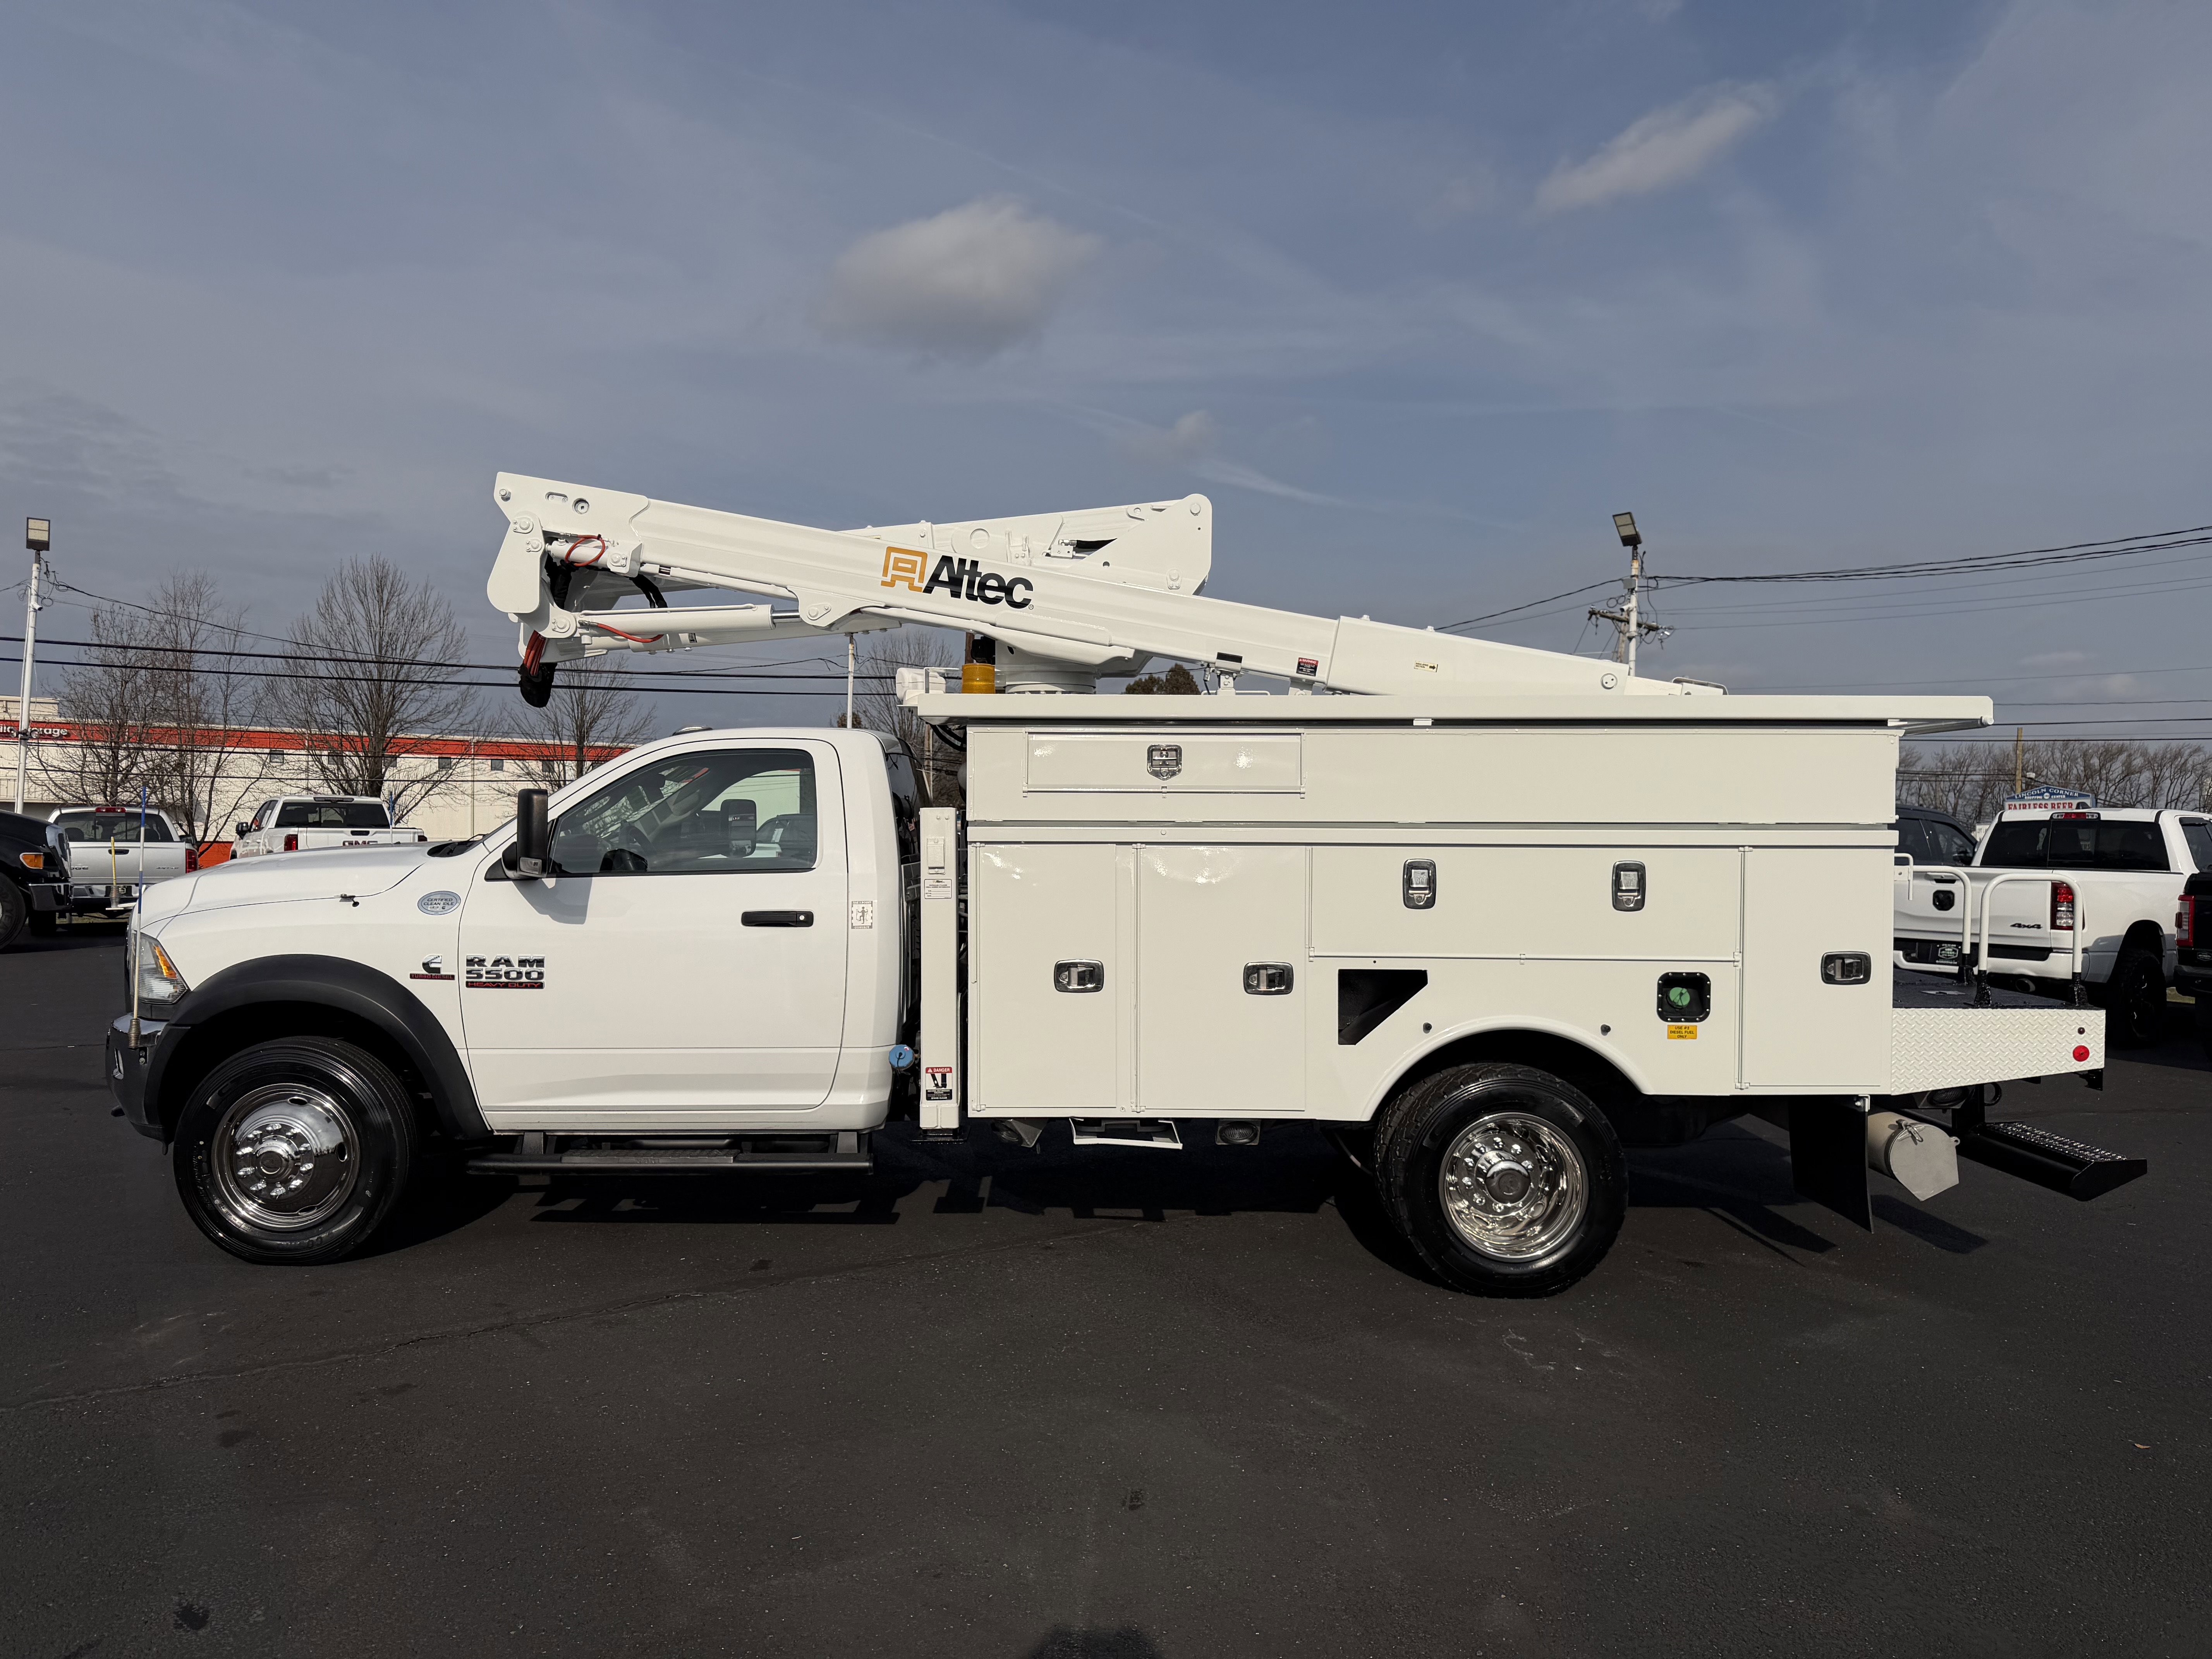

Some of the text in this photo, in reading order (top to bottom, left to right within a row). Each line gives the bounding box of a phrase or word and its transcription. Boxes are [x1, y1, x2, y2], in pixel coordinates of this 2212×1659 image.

[922, 555, 1034, 609] Altec
[2015, 788, 2079, 799] LINCOLN CORNER
[466, 955, 545, 968] RAM
[466, 968, 544, 981] 5500
